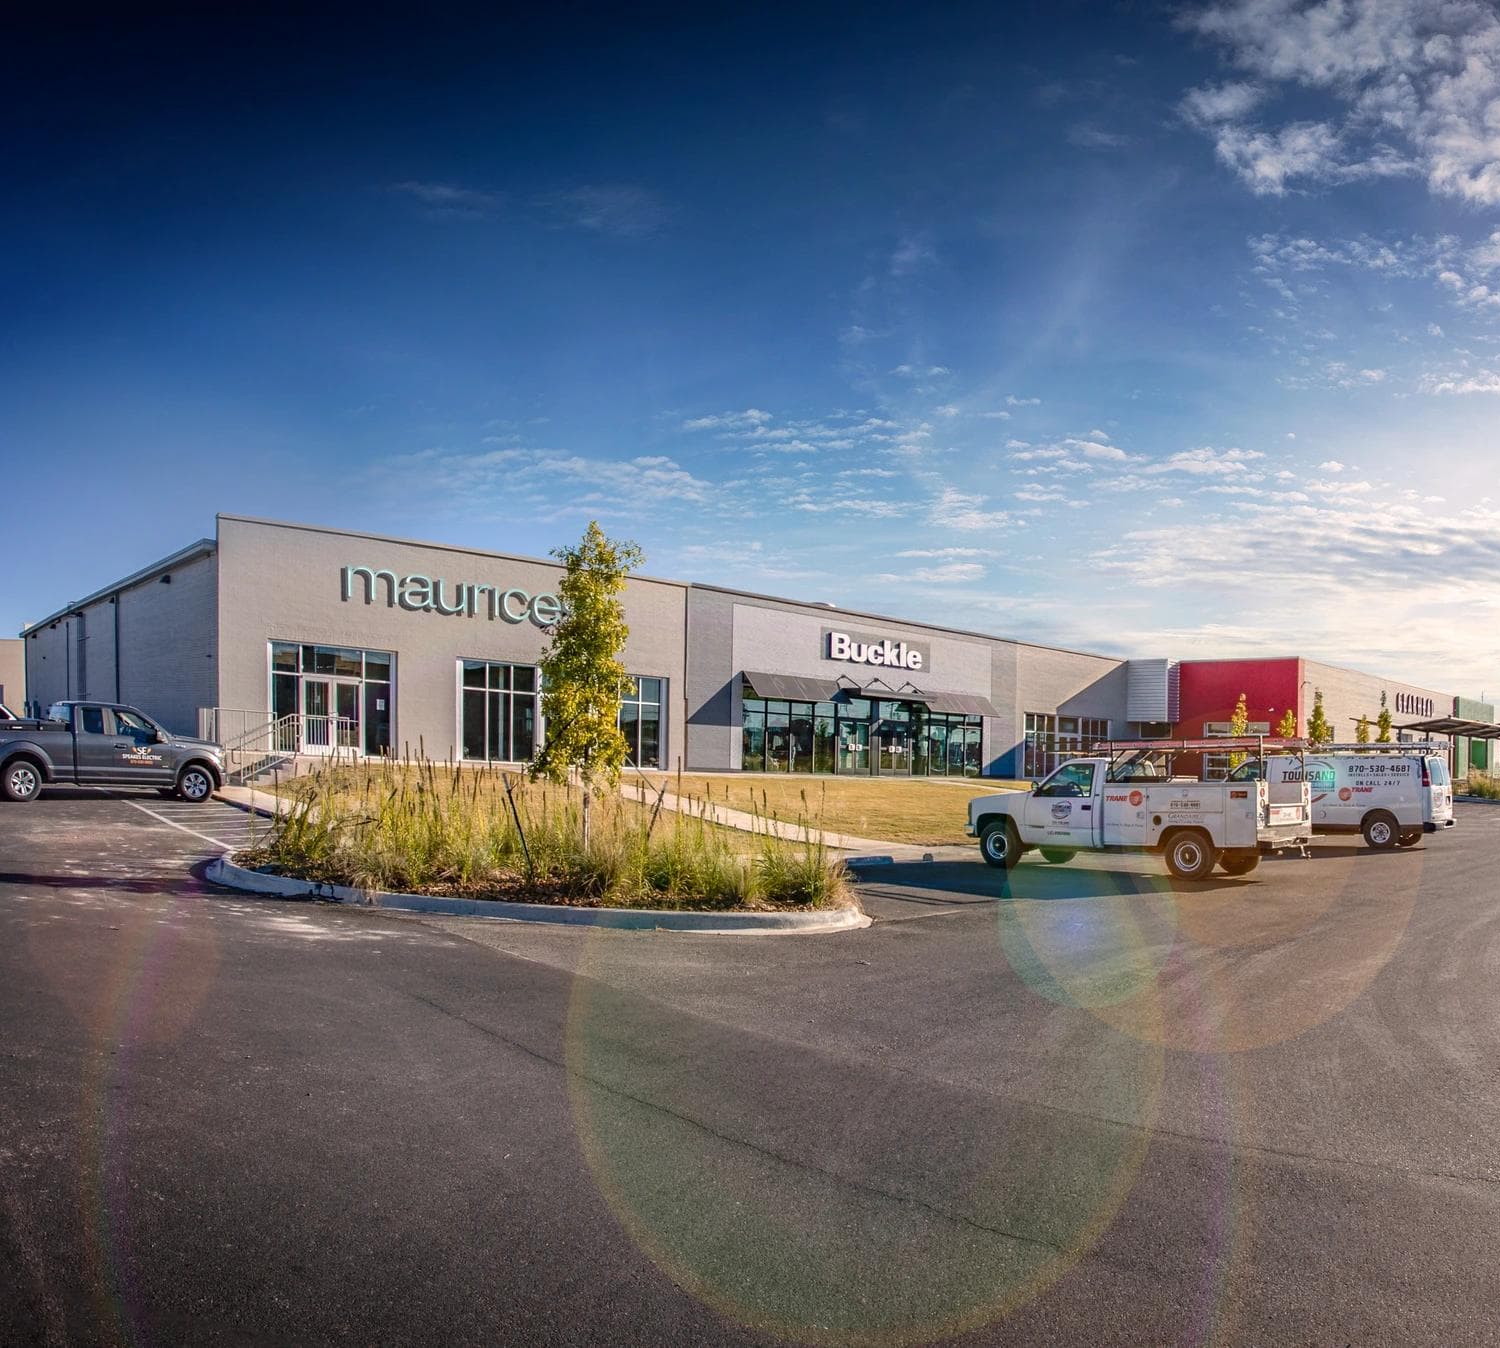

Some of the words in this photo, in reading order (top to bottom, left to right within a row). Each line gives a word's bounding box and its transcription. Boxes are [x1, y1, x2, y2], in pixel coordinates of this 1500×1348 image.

[340, 566, 567, 628] maurice
[826, 631, 922, 669] Buckle
[137, 746, 148, 755] SE
